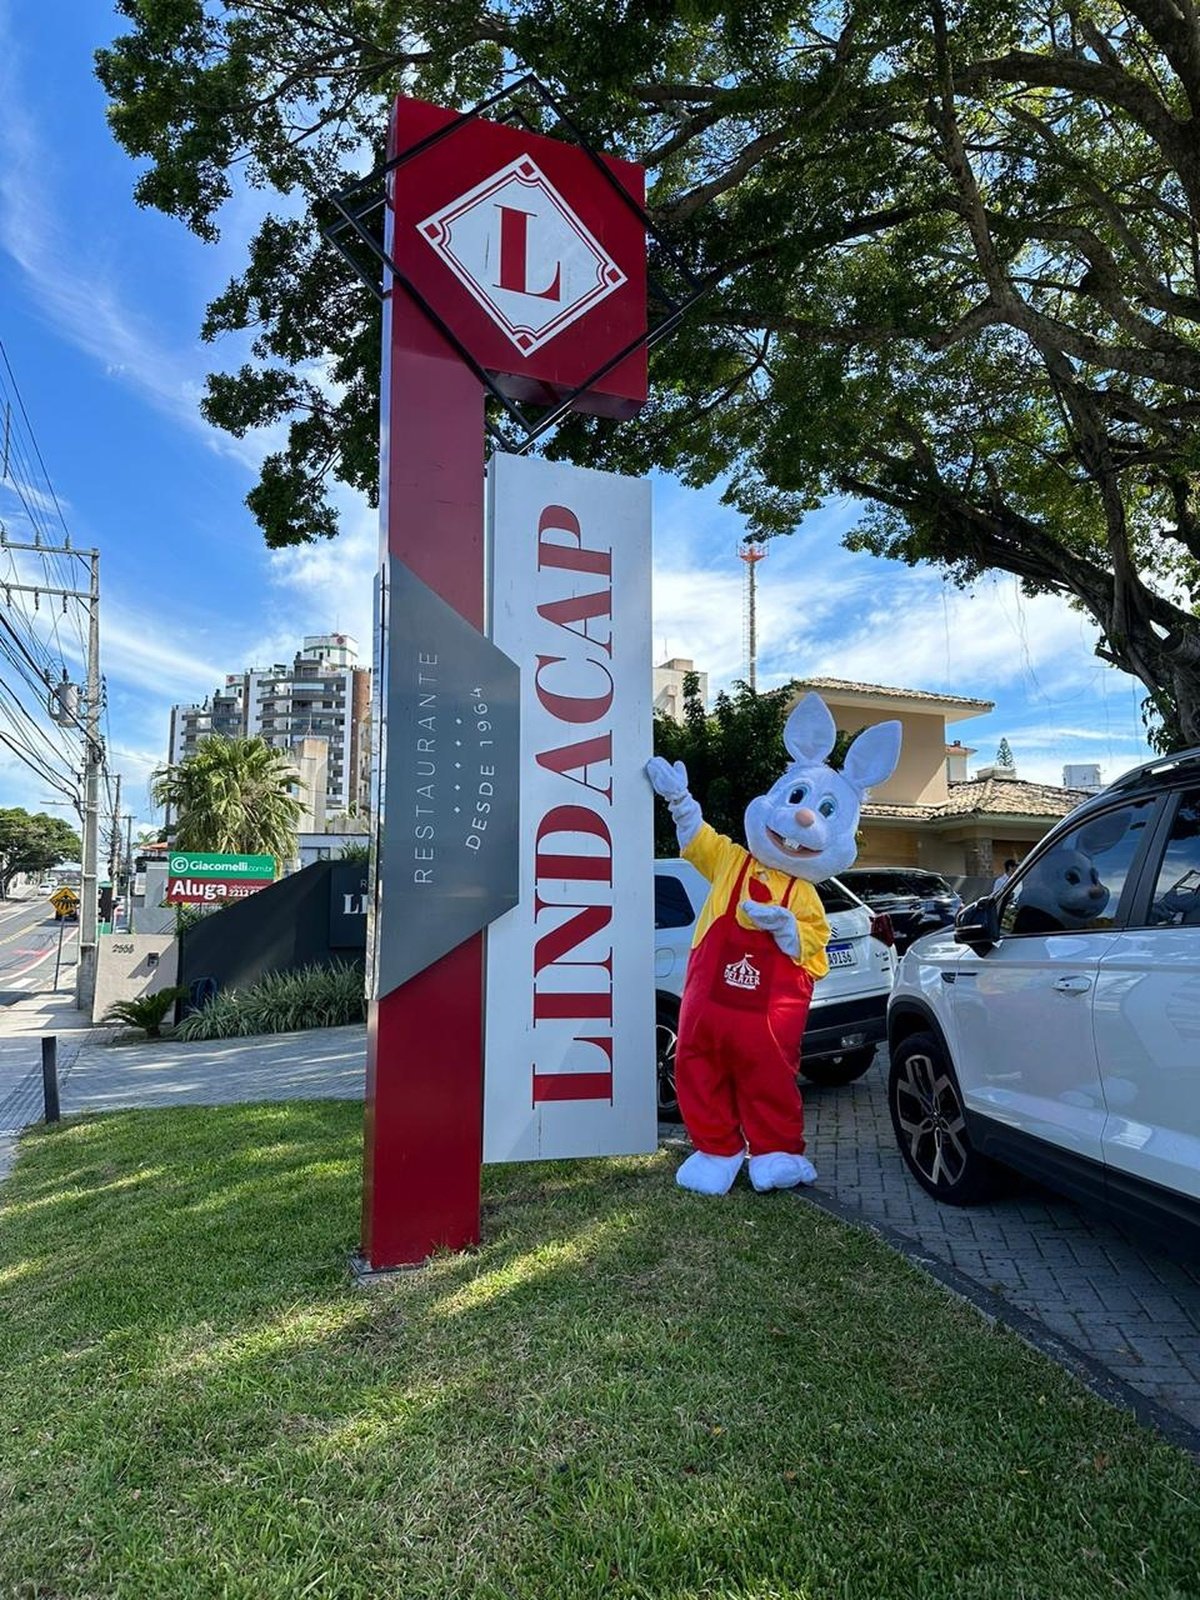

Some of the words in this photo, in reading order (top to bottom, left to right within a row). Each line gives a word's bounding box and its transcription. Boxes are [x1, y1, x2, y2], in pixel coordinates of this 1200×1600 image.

[492, 203, 561, 303] L
[468, 686, 493, 748] 1964
[413, 651, 439, 885] RESTAURANTE
[464, 763, 496, 851] DESDE
[532, 504, 614, 1110] LINDACAP
[171, 879, 228, 901] Aluga
